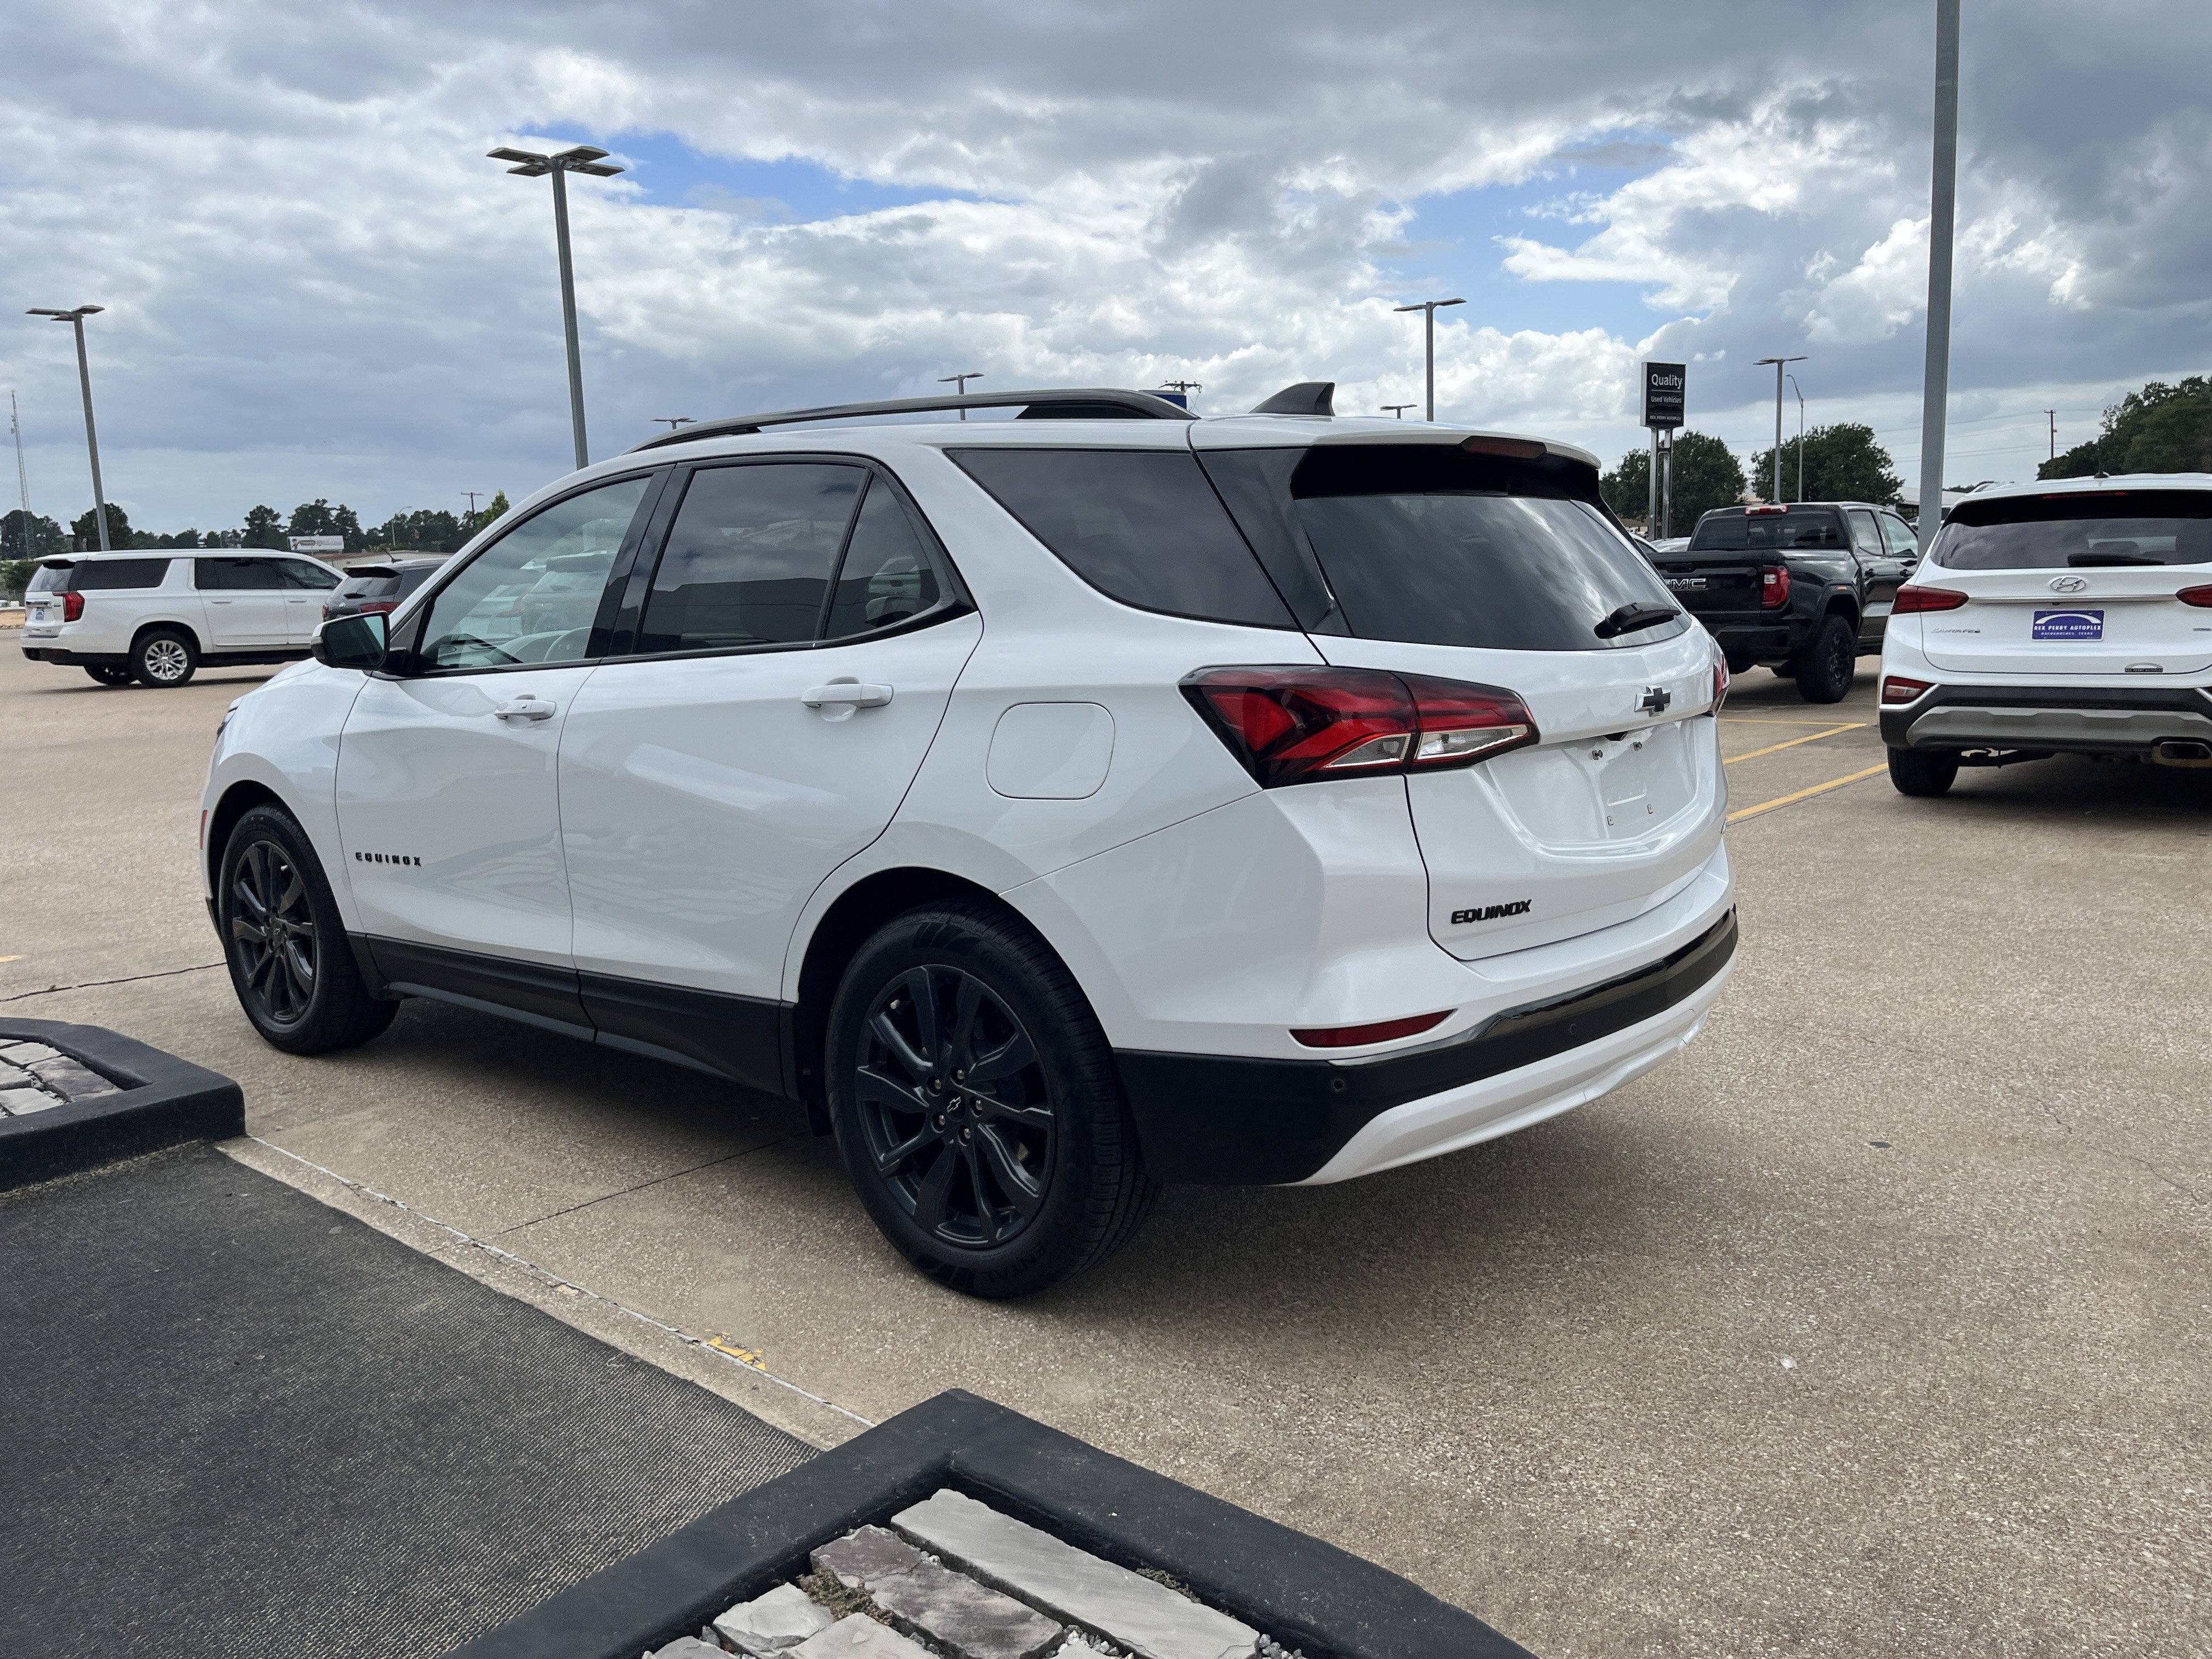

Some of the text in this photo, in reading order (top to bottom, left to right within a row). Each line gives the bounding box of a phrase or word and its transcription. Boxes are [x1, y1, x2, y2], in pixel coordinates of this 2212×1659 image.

[1651, 374, 1683, 390] Quality
[355, 852, 422, 867] EQUINOX
[1451, 899, 1532, 924] EQUINOX
